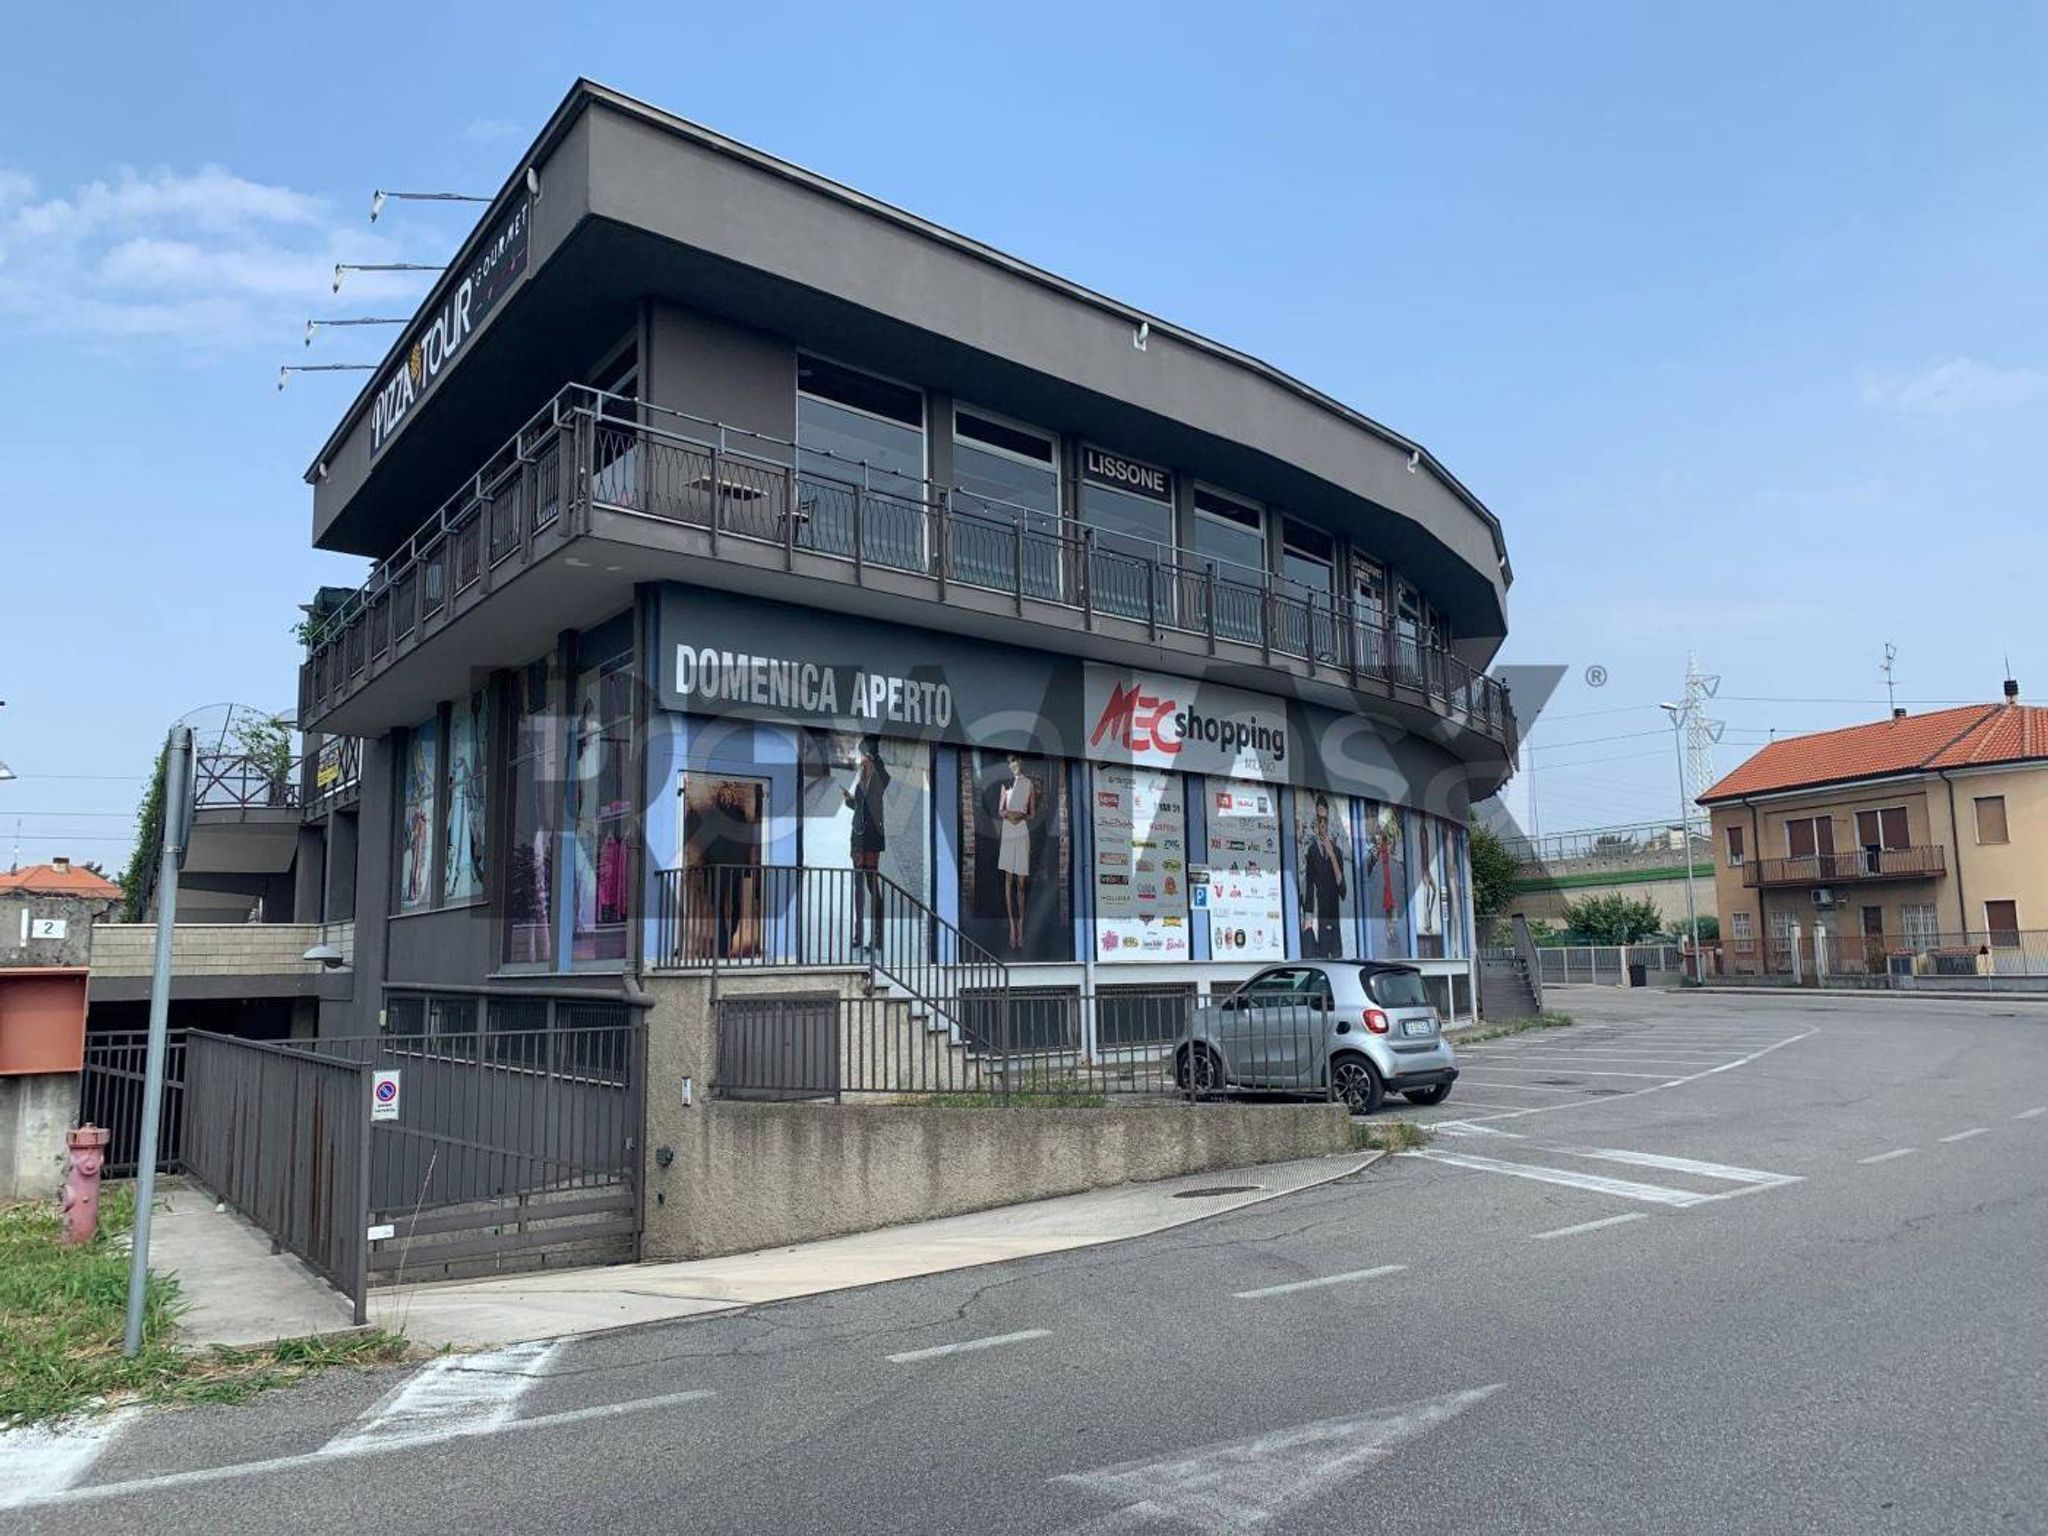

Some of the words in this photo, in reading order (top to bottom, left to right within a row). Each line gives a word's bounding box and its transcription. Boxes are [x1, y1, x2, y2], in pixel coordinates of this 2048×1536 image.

[475, 202, 528, 286] GOURMET
[371, 363, 416, 449] PIZZA
[420, 277, 472, 388] TOUR
[1087, 449, 1165, 492] LISSONE
[675, 644, 838, 715] DOMENICA
[850, 671, 952, 729] APERTO
[1090, 680, 1183, 754] MEC
[1174, 704, 1285, 761] shopping
[44, 921, 54, 934] 2
